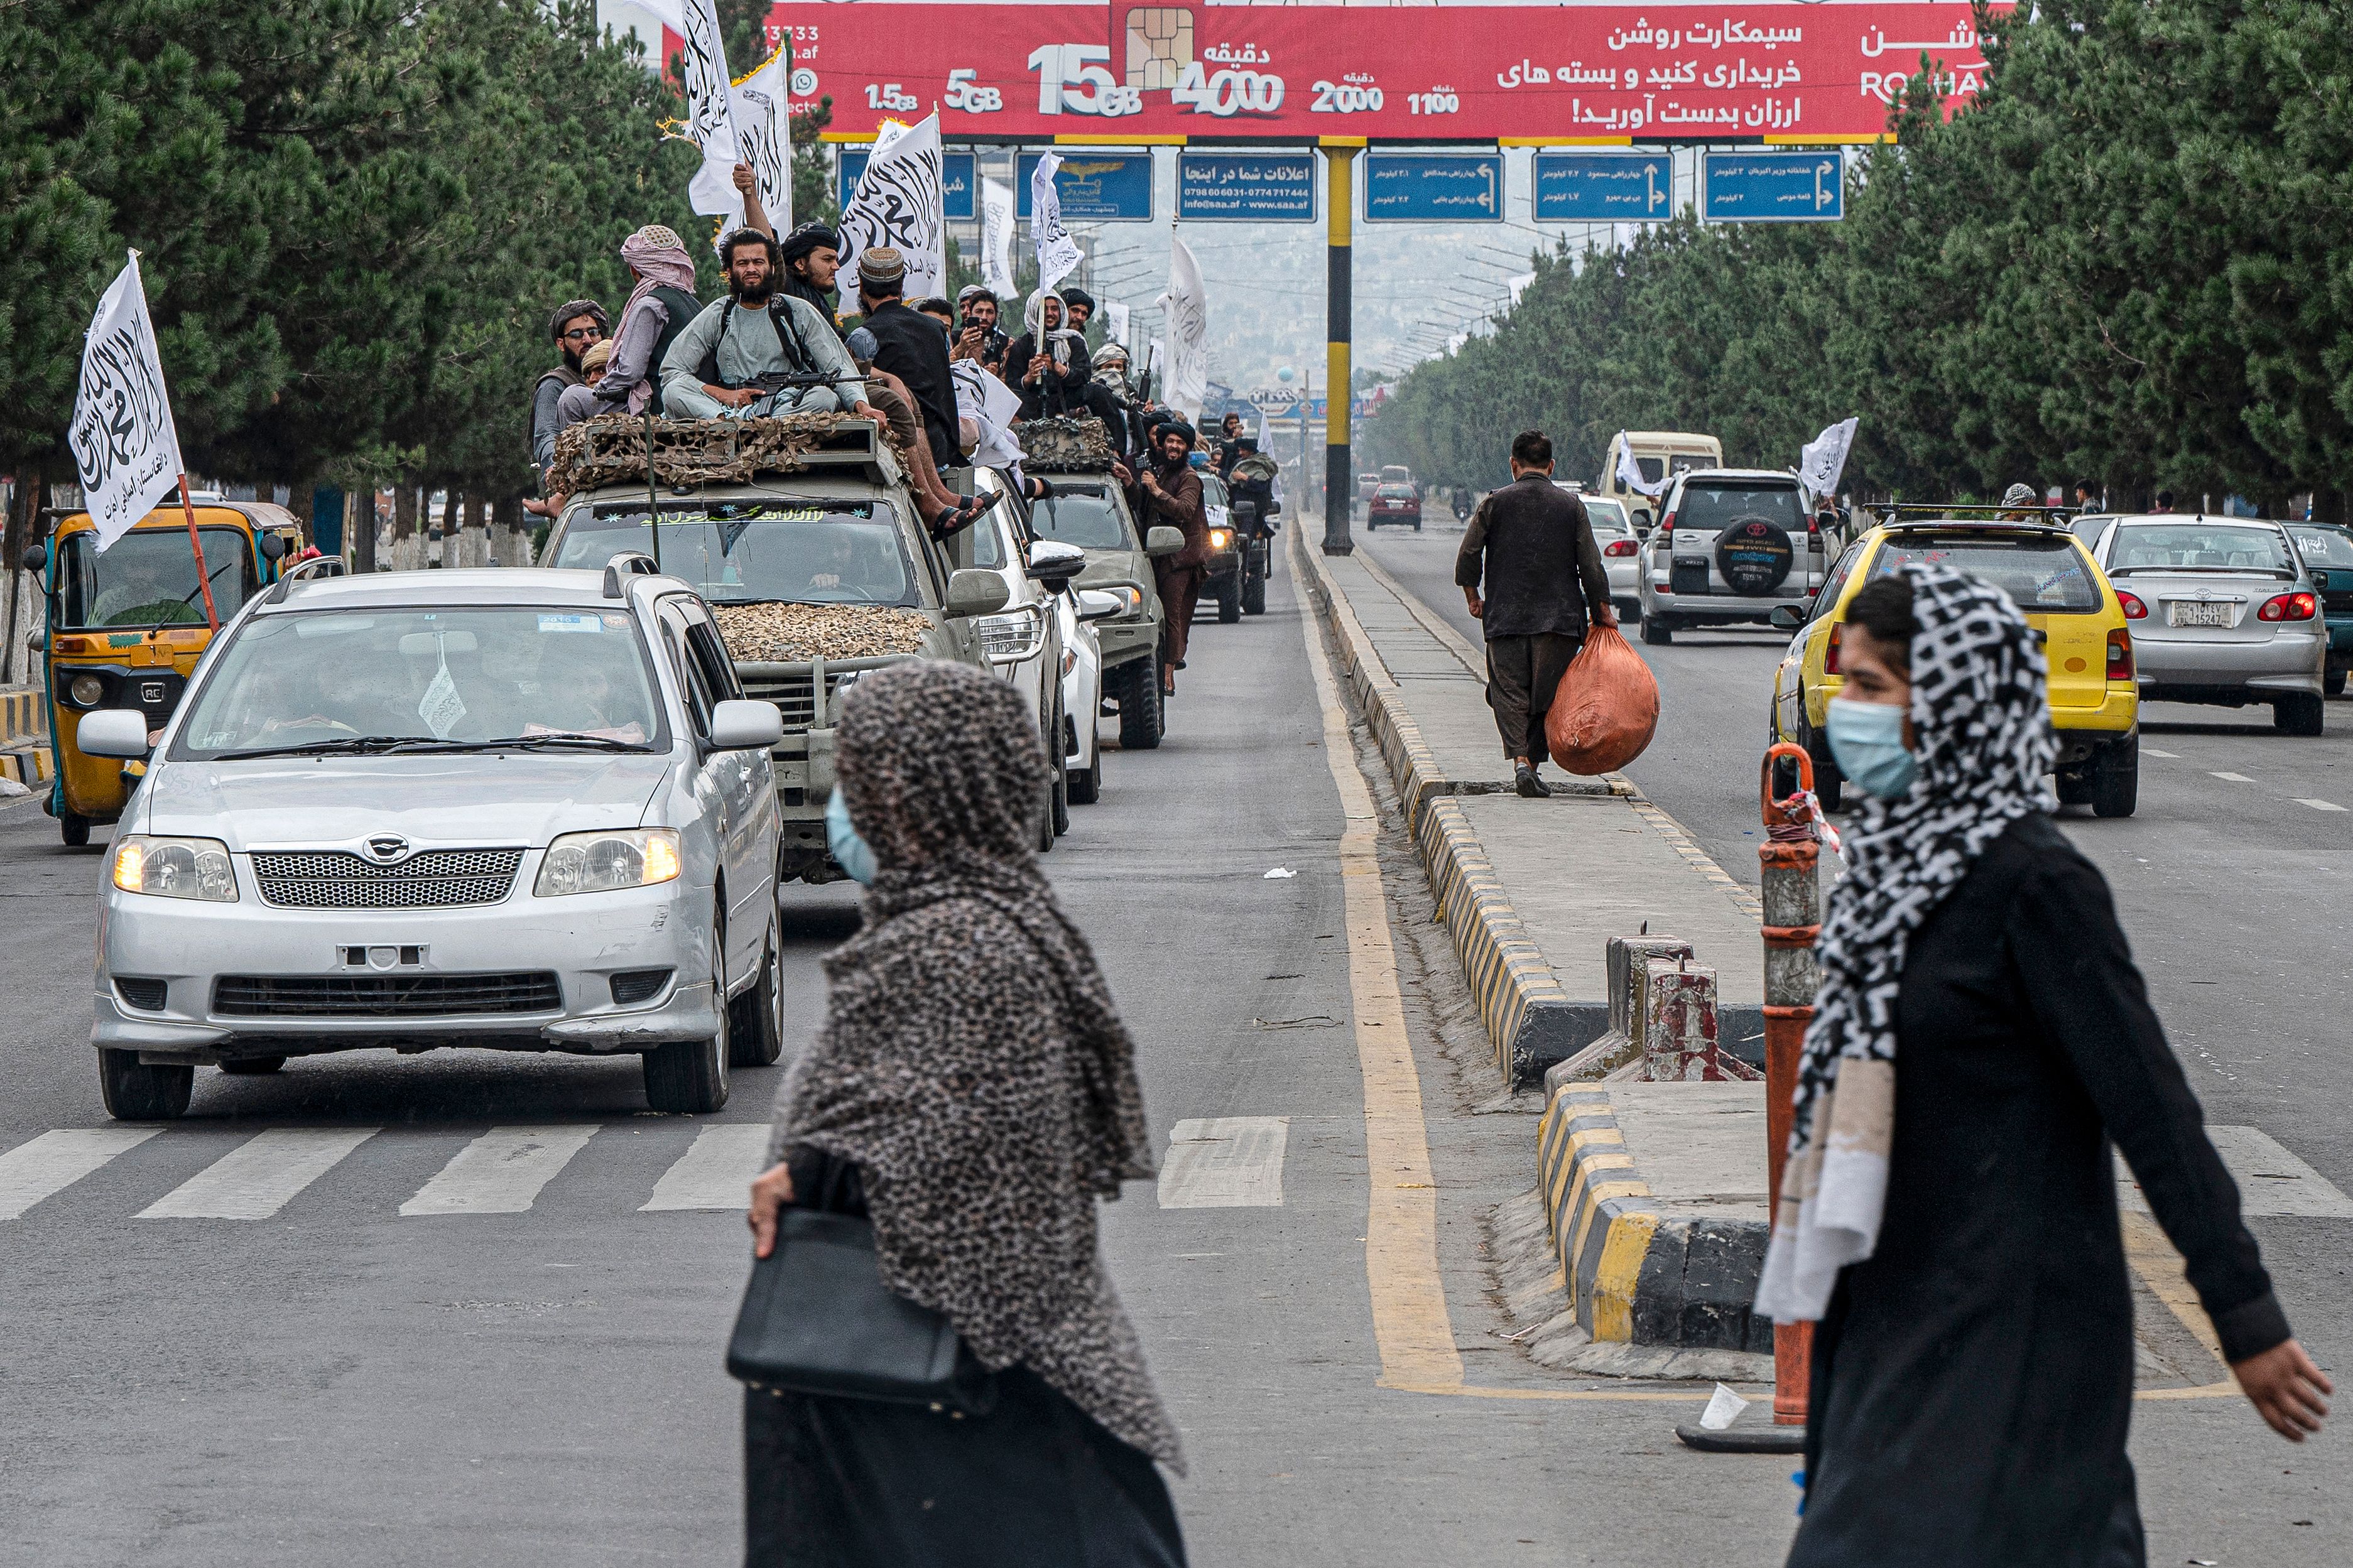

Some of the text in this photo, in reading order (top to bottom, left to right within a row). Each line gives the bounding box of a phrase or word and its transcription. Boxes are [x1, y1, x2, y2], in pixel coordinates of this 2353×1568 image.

[1608, 17, 1801, 50] سیمکارت روشن
[1204, 43, 1270, 68] دقیقه
[1028, 43, 1143, 117] 15GB
[1497, 58, 1801, 90] خریداری کنید و بسته های
[864, 84, 918, 111] 1.5GB
[944, 68, 1003, 113] 5GB
[1171, 62, 1284, 116] 4000
[1310, 80, 1383, 113] 2000
[1407, 92, 1459, 114] 1100
[1660, 102, 1739, 130] بدست
[1745, 97, 1801, 128] ارزان
[1185, 166, 1216, 184] اینجا
[1219, 168, 1236, 184] در
[1239, 166, 1261, 181] شما
[2195, 614, 2221, 624] 15247
